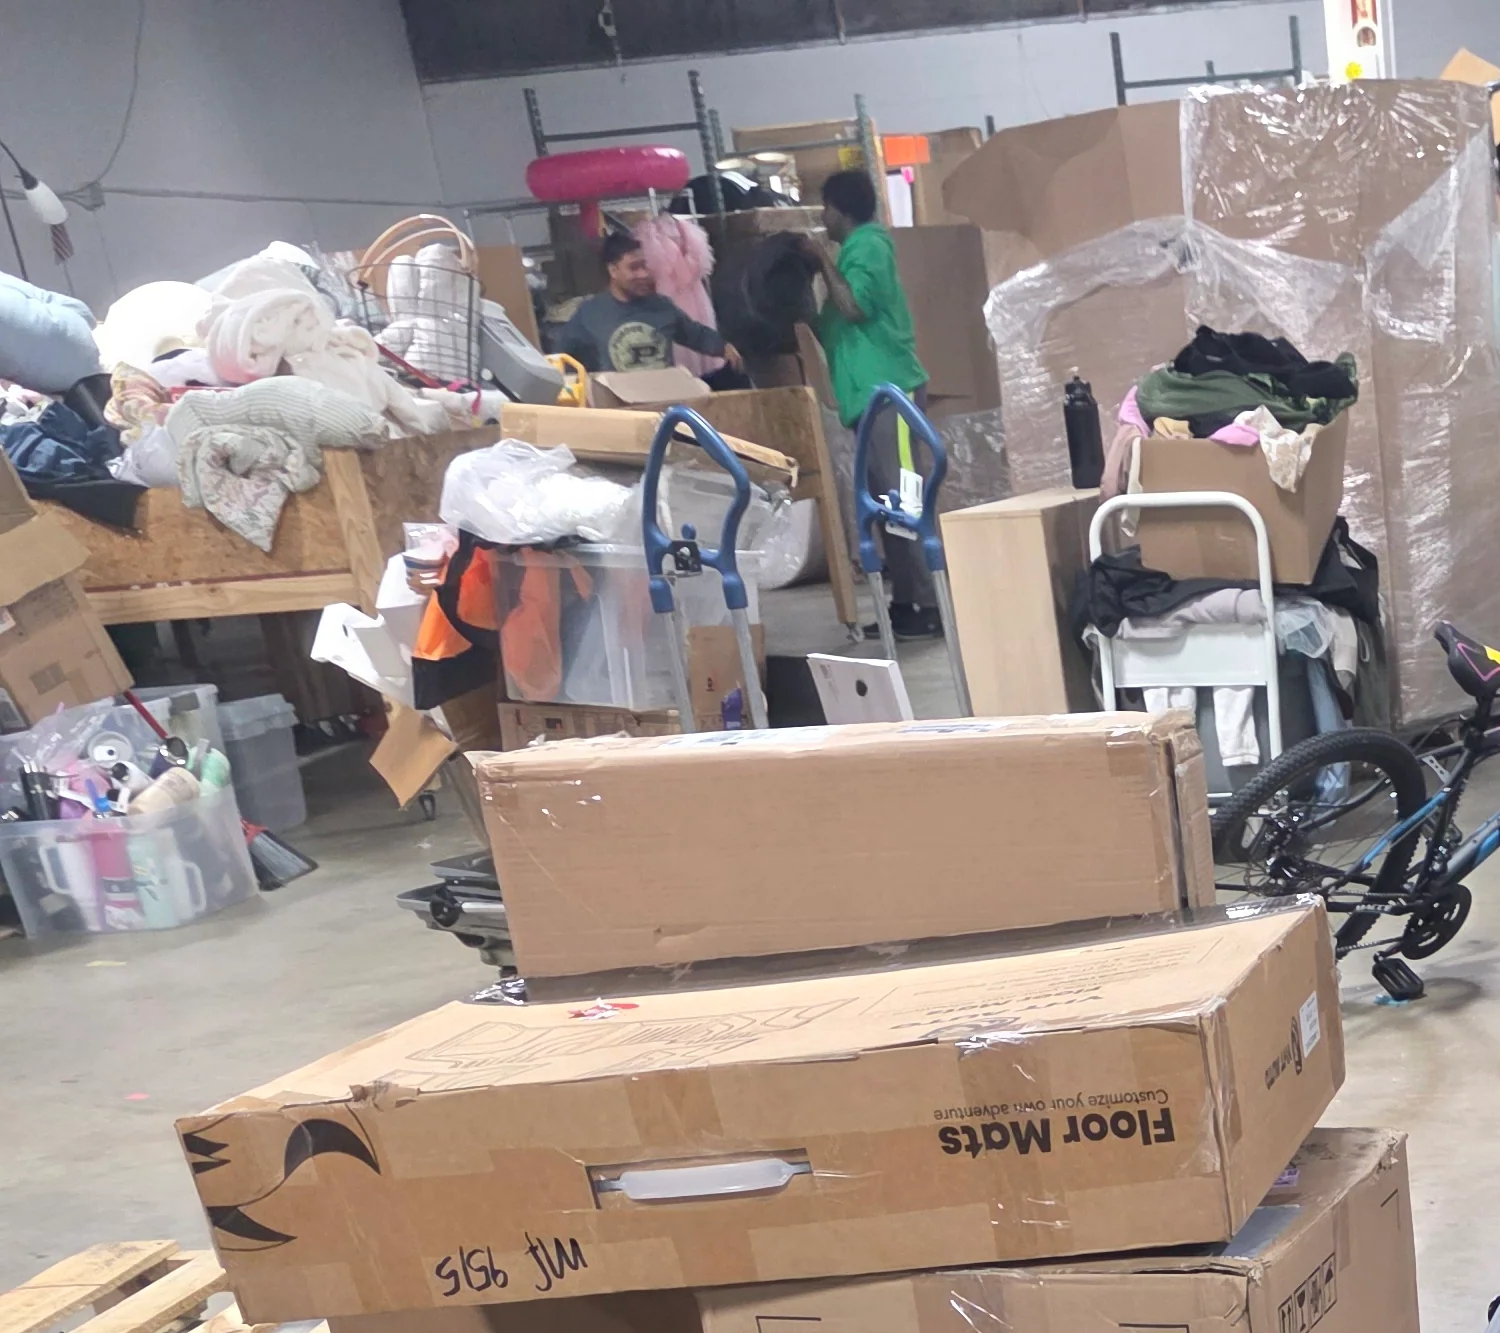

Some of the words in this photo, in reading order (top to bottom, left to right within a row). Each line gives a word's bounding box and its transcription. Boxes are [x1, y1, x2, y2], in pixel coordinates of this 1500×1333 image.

[1051, 1092, 1084, 1110] your
[1089, 1088, 1169, 1109] Customize
[933, 1103, 1009, 1121] adventure
[1063, 1107, 1175, 1146] Floor
[938, 1118, 1051, 1159] Mats
